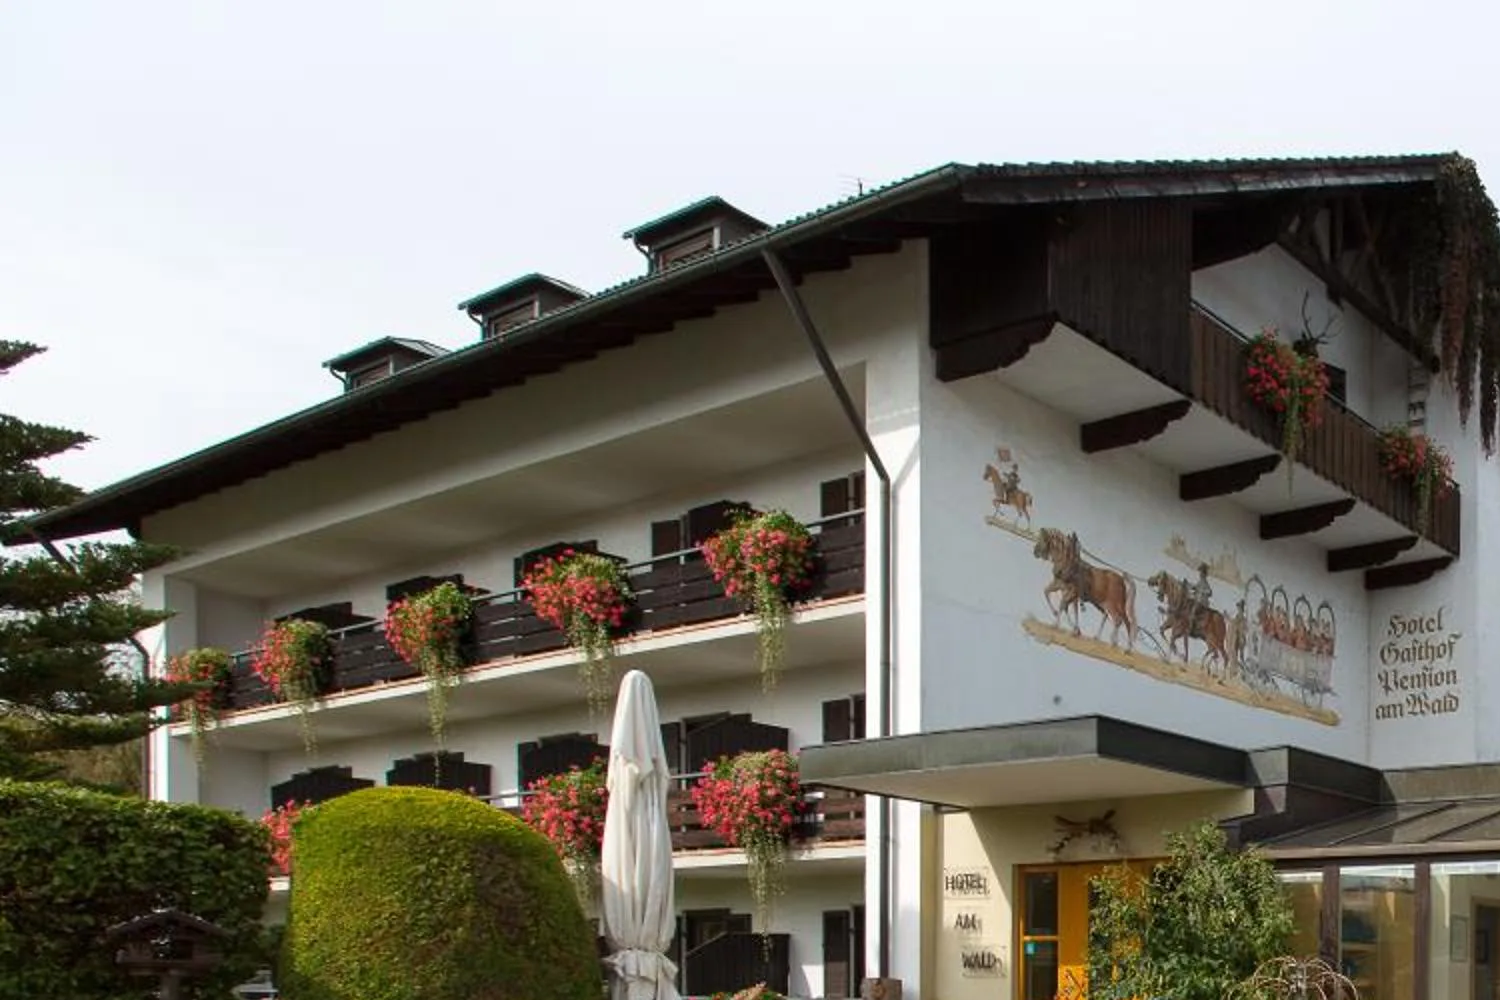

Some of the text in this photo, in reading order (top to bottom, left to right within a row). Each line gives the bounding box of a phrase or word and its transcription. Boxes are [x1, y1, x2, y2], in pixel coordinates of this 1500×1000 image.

[1387, 605, 1446, 639] Hotel
[1375, 691, 1459, 720] am Wald
[945, 873, 987, 893] HOTEL
[953, 912, 977, 931] AM
[961, 951, 998, 970] WALD
